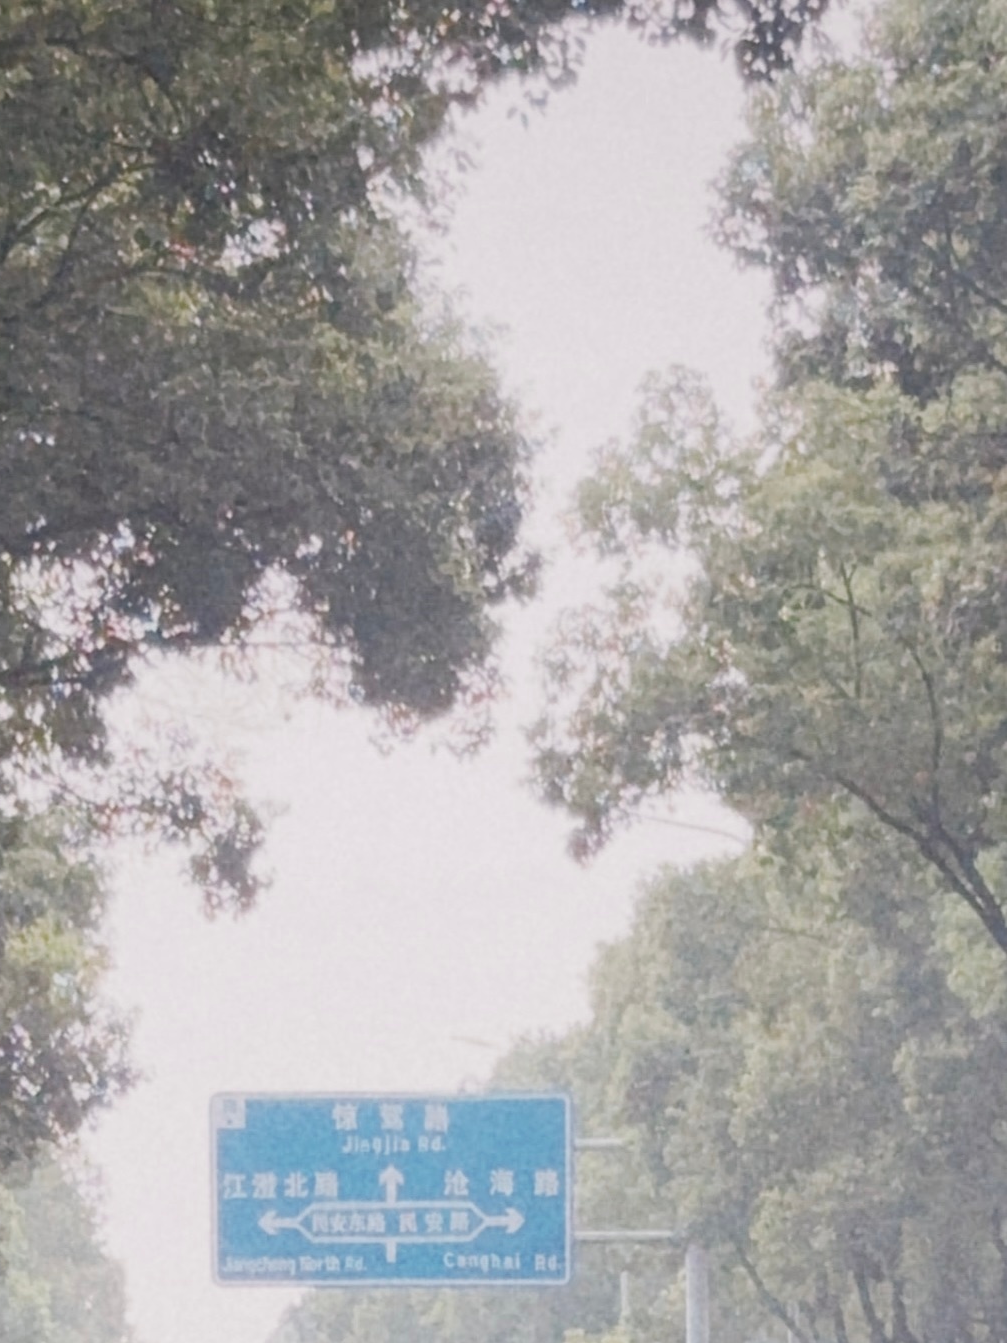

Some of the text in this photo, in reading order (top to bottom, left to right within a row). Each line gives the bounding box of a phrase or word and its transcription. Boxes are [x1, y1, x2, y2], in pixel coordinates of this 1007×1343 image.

[444, 1169, 559, 1196] 沧海路
[399, 1211, 470, 1233] 民安路
[444, 1252, 521, 1273] Canghai
